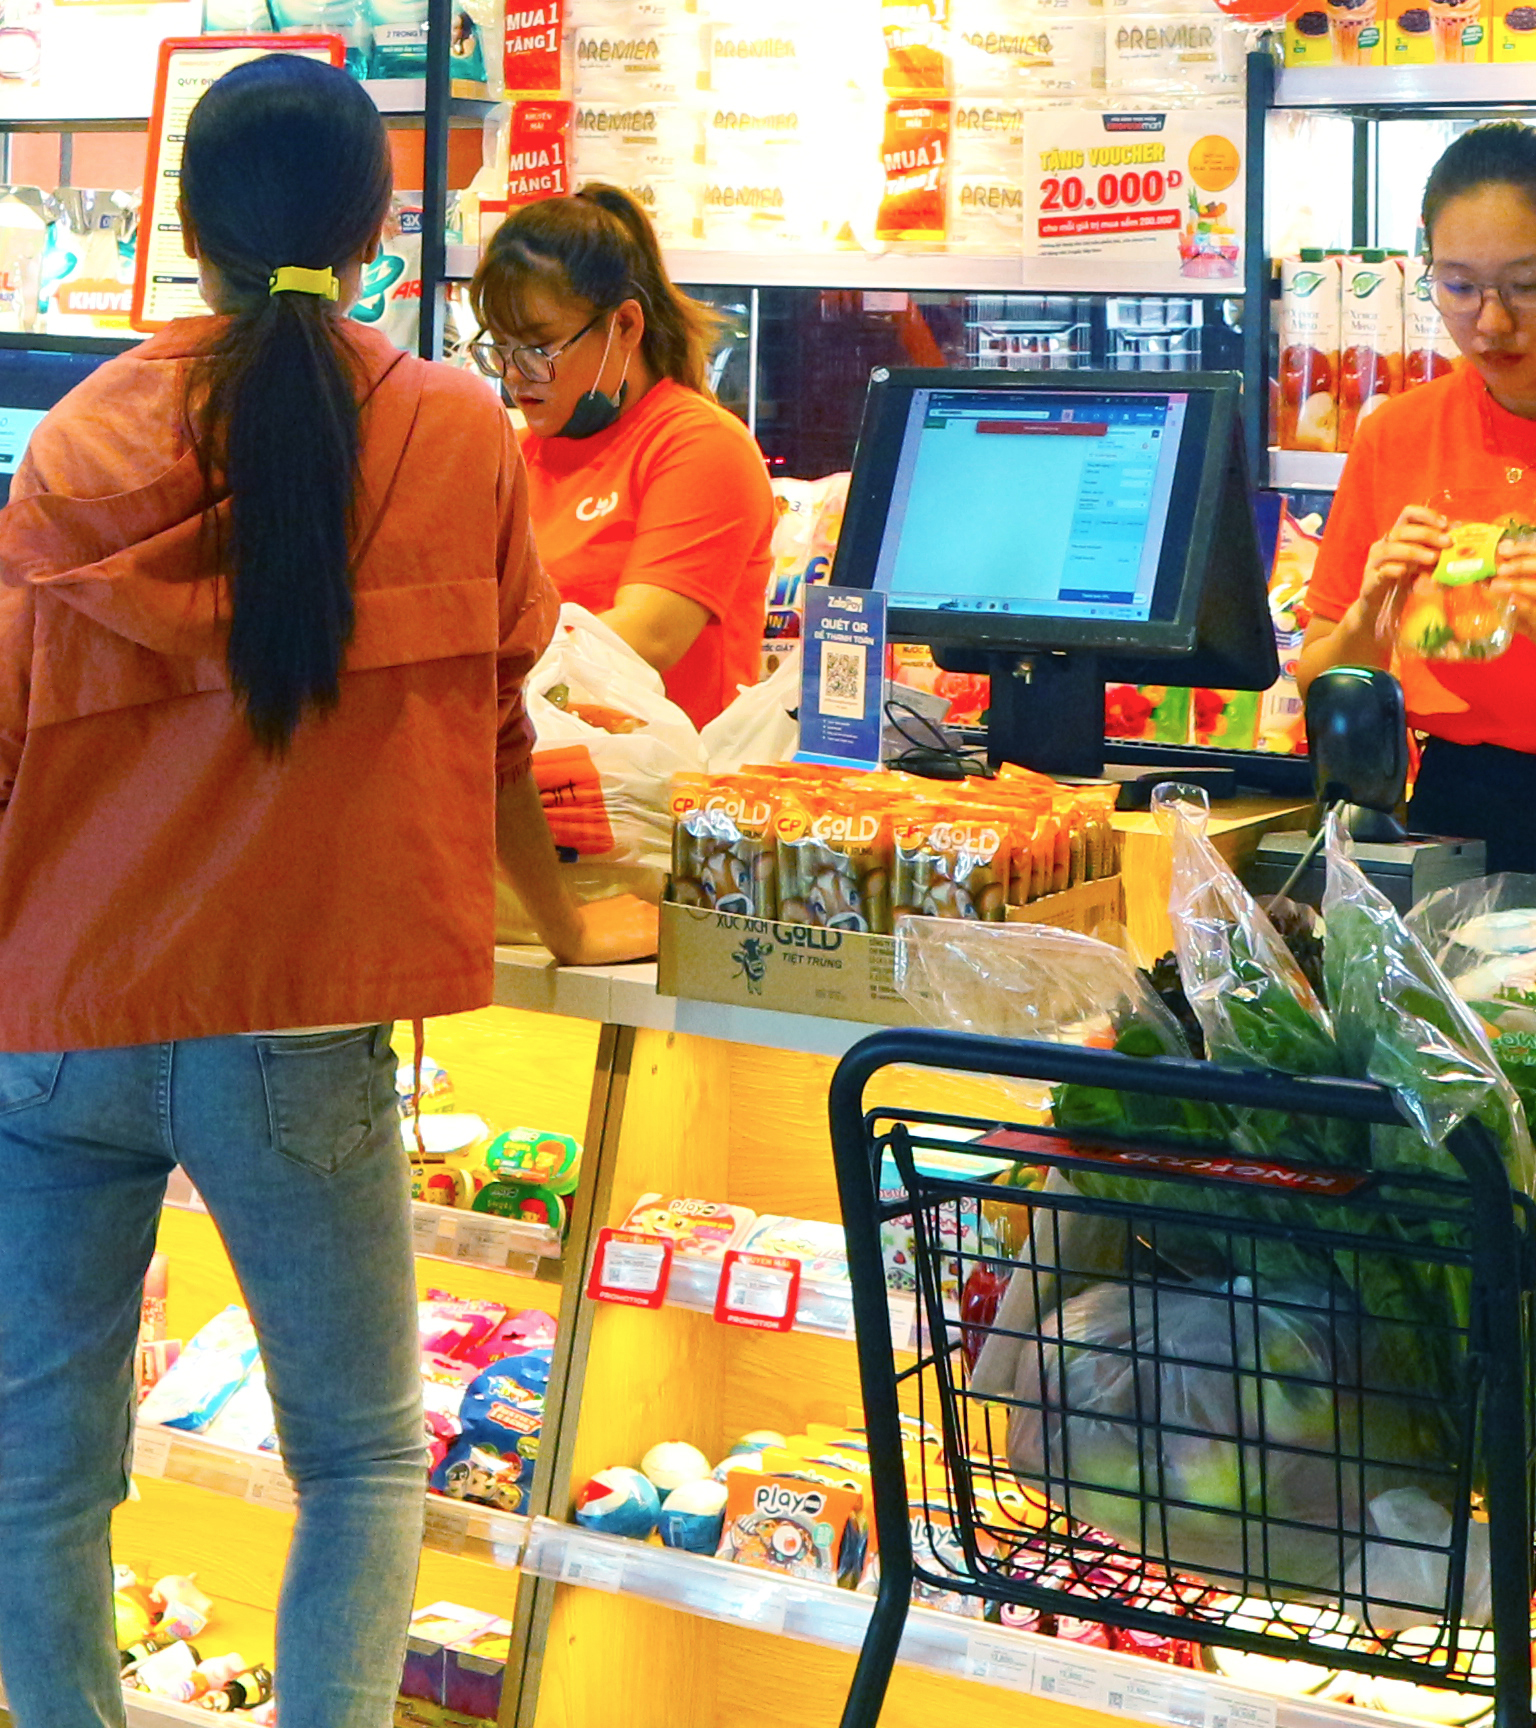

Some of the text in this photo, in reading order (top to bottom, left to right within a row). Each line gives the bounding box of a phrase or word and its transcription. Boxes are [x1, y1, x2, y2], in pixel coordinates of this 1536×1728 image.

[507, 2, 559, 32] MUA 1
[546, 28, 558, 53] 1
[578, 38, 659, 61] PREMIER
[1117, 26, 1213, 50] PREMIER
[576, 108, 657, 132] PREMIER
[510, 143, 563, 172] MUA 1
[884, 140, 945, 172] MUA 1
[1087, 142, 1166, 167] VOUCHER
[552, 169, 564, 194] 1
[926, 168, 938, 192] 1
[403, 212, 421, 227] 3X
[69, 291, 132, 310] KHUYẾ
[821, 617, 869, 633] QUÉT QR
[672, 796, 694, 813] CP
[777, 817, 802, 832] CP
[599, 1291, 650, 1306] PROMOTION
[727, 1314, 780, 1329] PROMOTION
